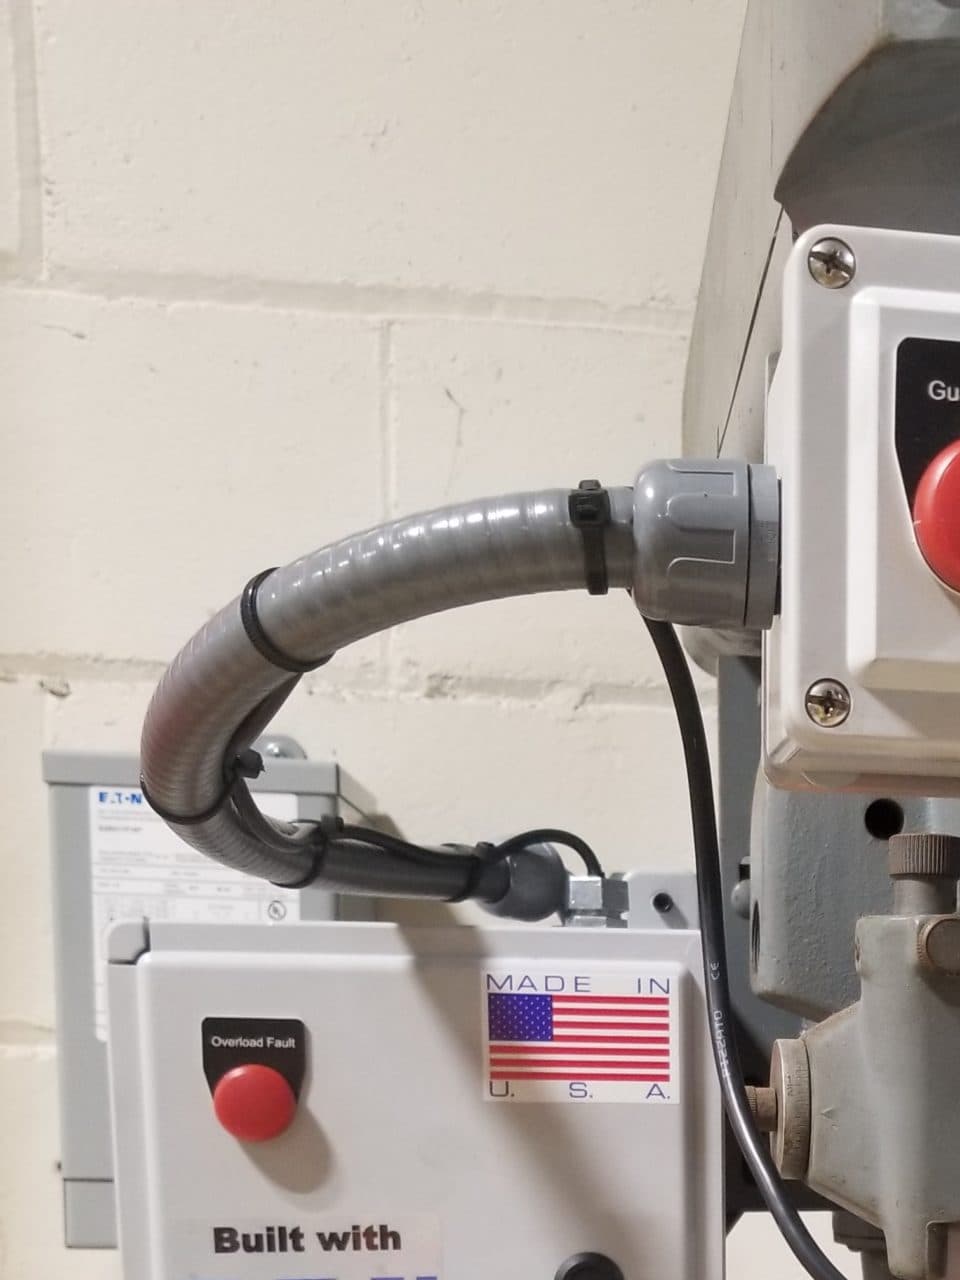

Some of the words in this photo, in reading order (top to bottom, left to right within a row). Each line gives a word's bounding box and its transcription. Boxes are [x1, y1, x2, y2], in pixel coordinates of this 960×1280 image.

[486, 973, 592, 993] MADE
[637, 977, 670, 995] IN
[211, 1035, 264, 1049] Overload
[266, 1036, 296, 1049] Fault
[213, 1224, 305, 1254] Built
[317, 1224, 402, 1252] with
